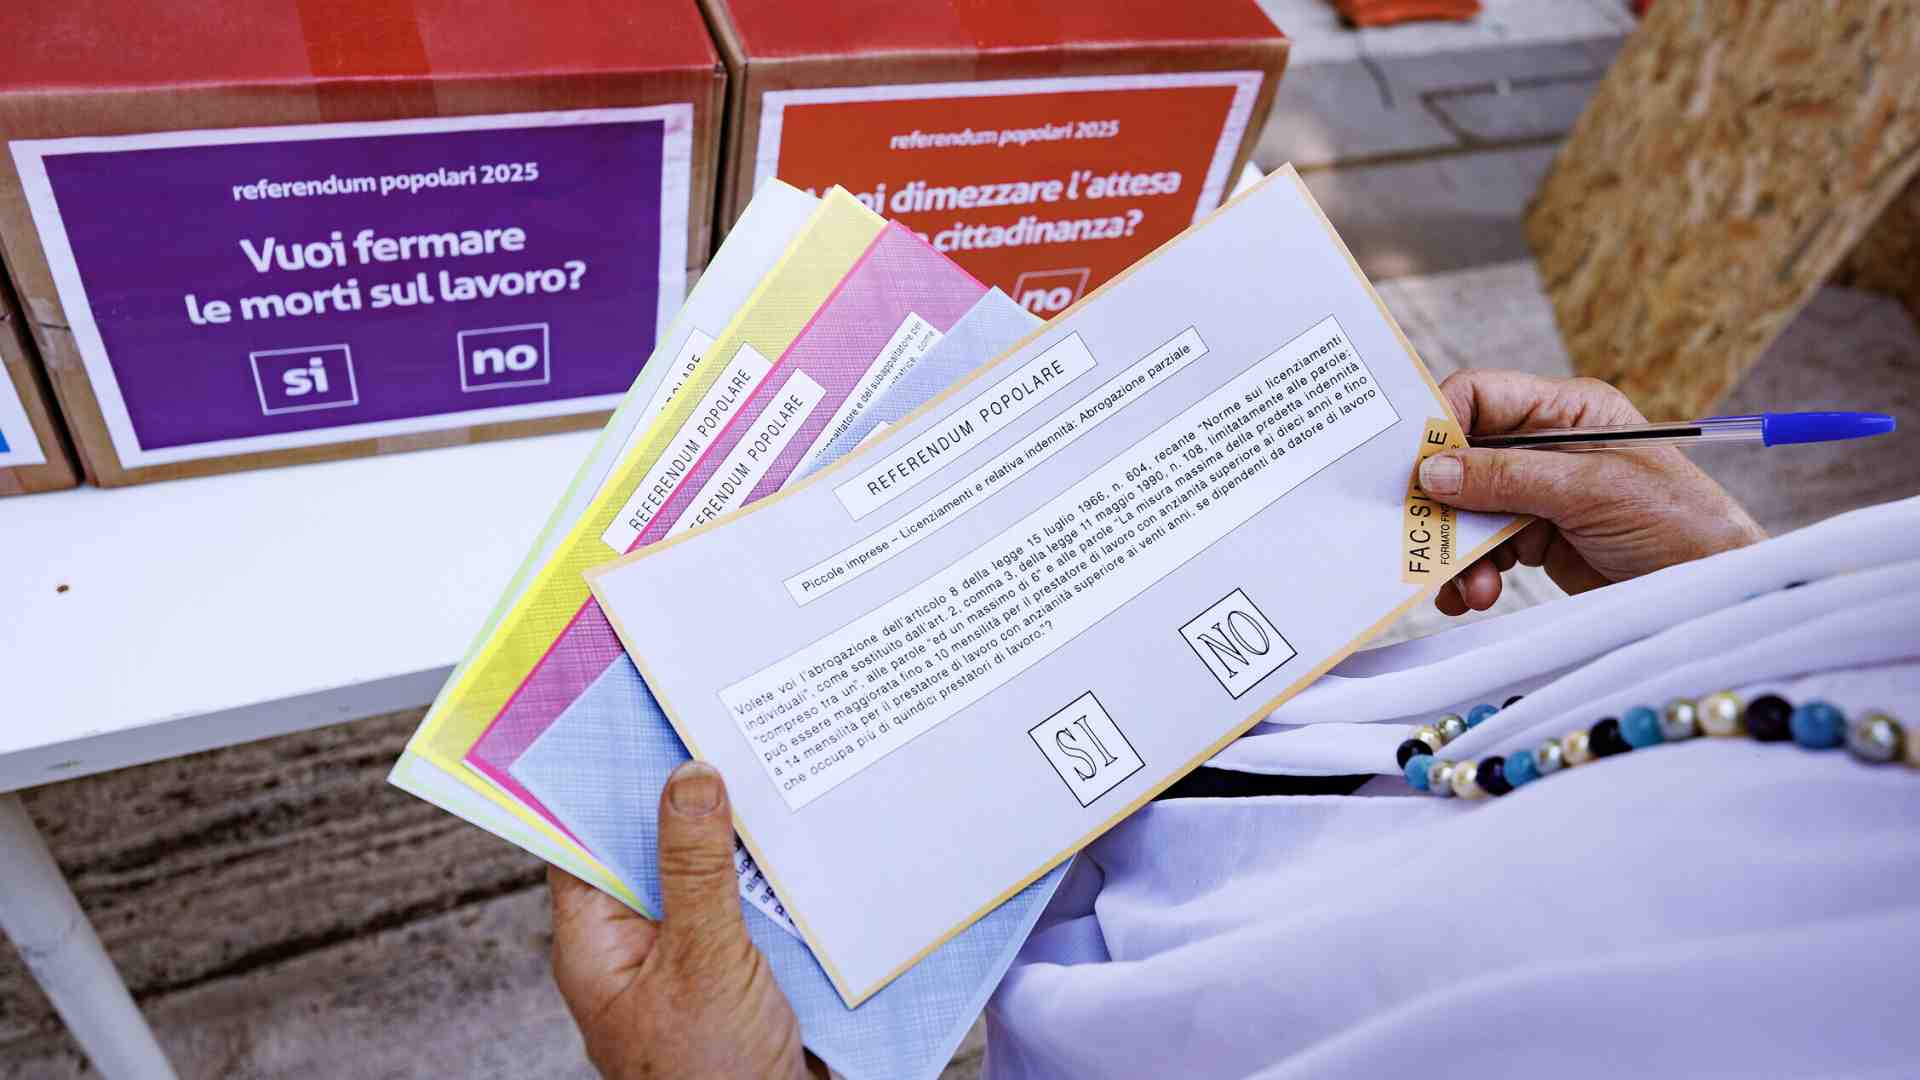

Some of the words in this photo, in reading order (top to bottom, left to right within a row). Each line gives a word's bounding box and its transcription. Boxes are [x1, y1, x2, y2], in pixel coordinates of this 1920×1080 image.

[890, 128, 998, 150] referendum
[997, 122, 1073, 147] popolari
[1074, 119, 1120, 140] 2025
[233, 174, 376, 201] referendum
[380, 165, 477, 196] popolari
[480, 162, 539, 184] 2025
[890, 179, 1063, 214] dimezzare
[239, 230, 347, 273] Vuoi
[353, 226, 526, 265] fermare
[933, 209, 1143, 253] cittadinanza?
[184, 293, 232, 325] le
[240, 278, 362, 320] morti
[371, 272, 434, 309] sul
[439, 260, 587, 302] lavoro?
[1022, 287, 1072, 313] no
[282, 357, 329, 396] si
[472, 344, 539, 376] no
[628, 439, 701, 531] REFERENDUM
[697, 368, 752, 438] POPOLARE
[747, 394, 804, 461] POPOLARE
[866, 419, 974, 495] REFERENDUM
[978, 359, 1064, 423] POPOLARE
[801, 566, 844, 592] Piccole
[845, 541, 889, 569] imprese
[898, 489, 973, 538] Licenziamenti
[984, 456, 1024, 486] relativa
[1023, 420, 1077, 459] indennità:
[1079, 375, 1145, 423] Abrogazione
[1146, 344, 1191, 379] parziale
[733, 691, 774, 715] Volete
[777, 679, 797, 693] voi
[961, 568, 990, 589] della
[990, 546, 1024, 570] legge
[1026, 532, 1041, 546] 15
[1042, 513, 1075, 536] luglio
[1153, 431, 1196, 463] recante
[1244, 385, 1263, 402] sui
[1264, 333, 1342, 389] licenziamenti
[816, 669, 848, 692] come
[850, 639, 903, 672] sostituito
[962, 578, 1004, 607] comma
[1018, 551, 1047, 572] della
[1045, 529, 1078, 553] legge
[1079, 518, 1093, 530] 11
[1095, 491, 1135, 521] maggio
[1207, 392, 1284, 445] limitatamente
[1285, 377, 1308, 394] alle
[819, 695, 839, 708] tra
[865, 666, 888, 683] alle
[889, 644, 926, 671] parole
[948, 621, 964, 634] un
[965, 589, 1015, 624] massimo
[1017, 577, 1030, 591] di
[1055, 549, 1077, 566] alle
[1078, 525, 1113, 554] parole
[1135, 485, 1173, 514] misura
[1174, 451, 1224, 487] massima
[1225, 431, 1254, 453] della
[1255, 399, 1303, 435] predetta
[1303, 361, 1359, 400] indennità
[1409, 430, 1448, 574] FAC-SIE
[763, 741, 788, 763] può
[790, 717, 831, 746] essere
[833, 679, 900, 720] maggiorata
[899, 665, 922, 682] fino
[933, 647, 949, 661] 10
[950, 616, 1001, 652] mensilità
[1001, 603, 1020, 623] per
[1021, 595, 1031, 608] il
[1031, 561, 1089, 603] prestatore
[1088, 550, 1101, 563] di
[1099, 529, 1135, 555] lavoro
[1136, 514, 1157, 531] con
[1157, 479, 1208, 517] anzianità
[1208, 443, 1261, 482] superiore
[1263, 432, 1275, 447] ai
[1276, 413, 1304, 437] dieci
[1306, 395, 1332, 418] anni
[1343, 375, 1367, 394] fino
[1440, 523, 1451, 565] FORMATO
[784, 754, 800, 768] 14
[802, 720, 859, 758] mensilità
[859, 708, 880, 727] per
[880, 700, 892, 712] il
[891, 668, 949, 708] prestatore
[950, 658, 963, 671] di
[961, 638, 998, 663] lavoro
[999, 623, 1021, 640] con
[1022, 589, 1073, 626] anzianità
[1073, 555, 1125, 592] superiore
[1126, 544, 1138, 557] ai
[1138, 525, 1166, 548] venti
[1195, 497, 1210, 510] se
[1211, 456, 1269, 500] dipendenti
[1269, 447, 1286, 460] da
[1287, 422, 1324, 448] datore
[1325, 410, 1338, 424] di
[1337, 389, 1375, 416] lavoro
[1196, 610, 1270, 679] NO
[783, 772, 807, 791] che
[809, 744, 855, 775] occupa
[856, 729, 876, 748] più
[877, 721, 891, 733] di
[892, 695, 938, 725] quindici
[938, 659, 992, 700] prestatori
[993, 650, 1005, 664] di
[1055, 715, 1118, 782] SI
